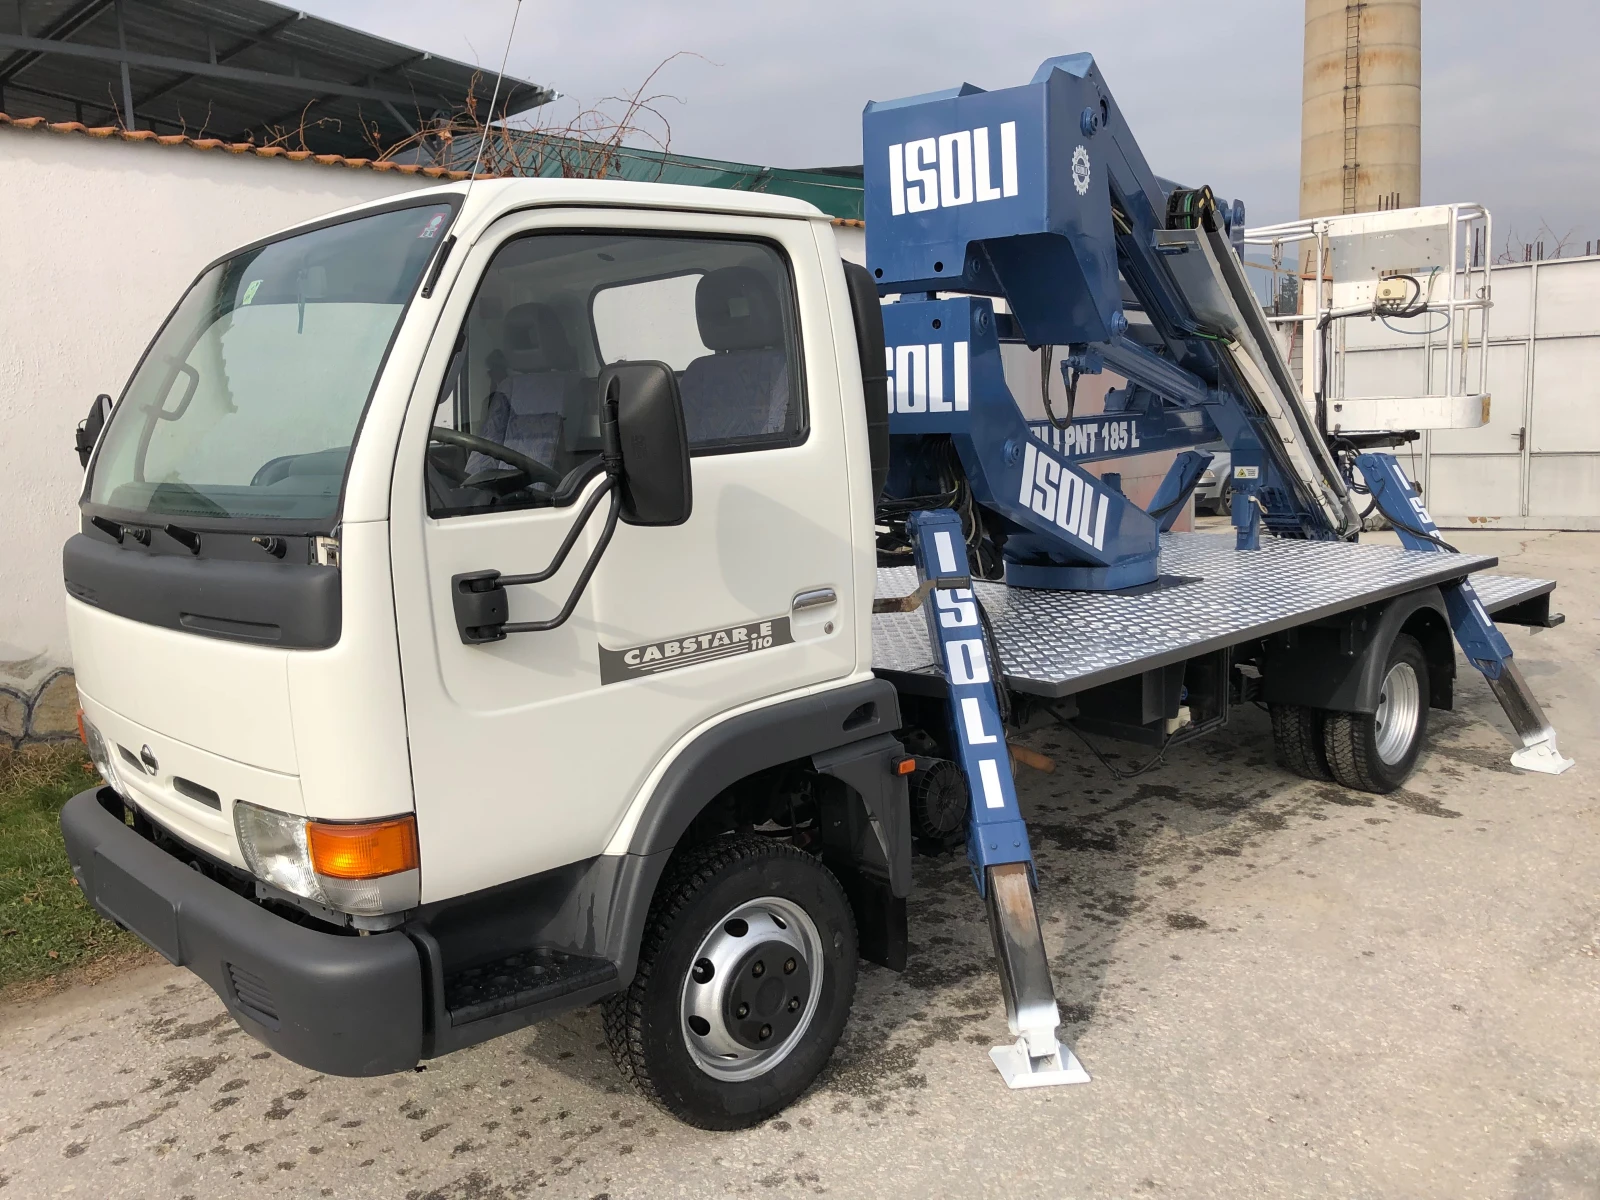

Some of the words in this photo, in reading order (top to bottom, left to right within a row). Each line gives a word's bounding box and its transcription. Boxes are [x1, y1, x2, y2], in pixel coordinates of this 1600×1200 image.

[889, 121, 1018, 216] ISOLI
[885, 341, 969, 414] OLI
[1064, 423, 1098, 457] PNT
[1102, 421, 1128, 452] 185
[1131, 420, 1140, 448] L
[1019, 442, 1109, 551] ISOLI
[623, 621, 773, 666] CABSTAR.E
[751, 636, 773, 651] 110
[933, 531, 1005, 809] ISOLI
